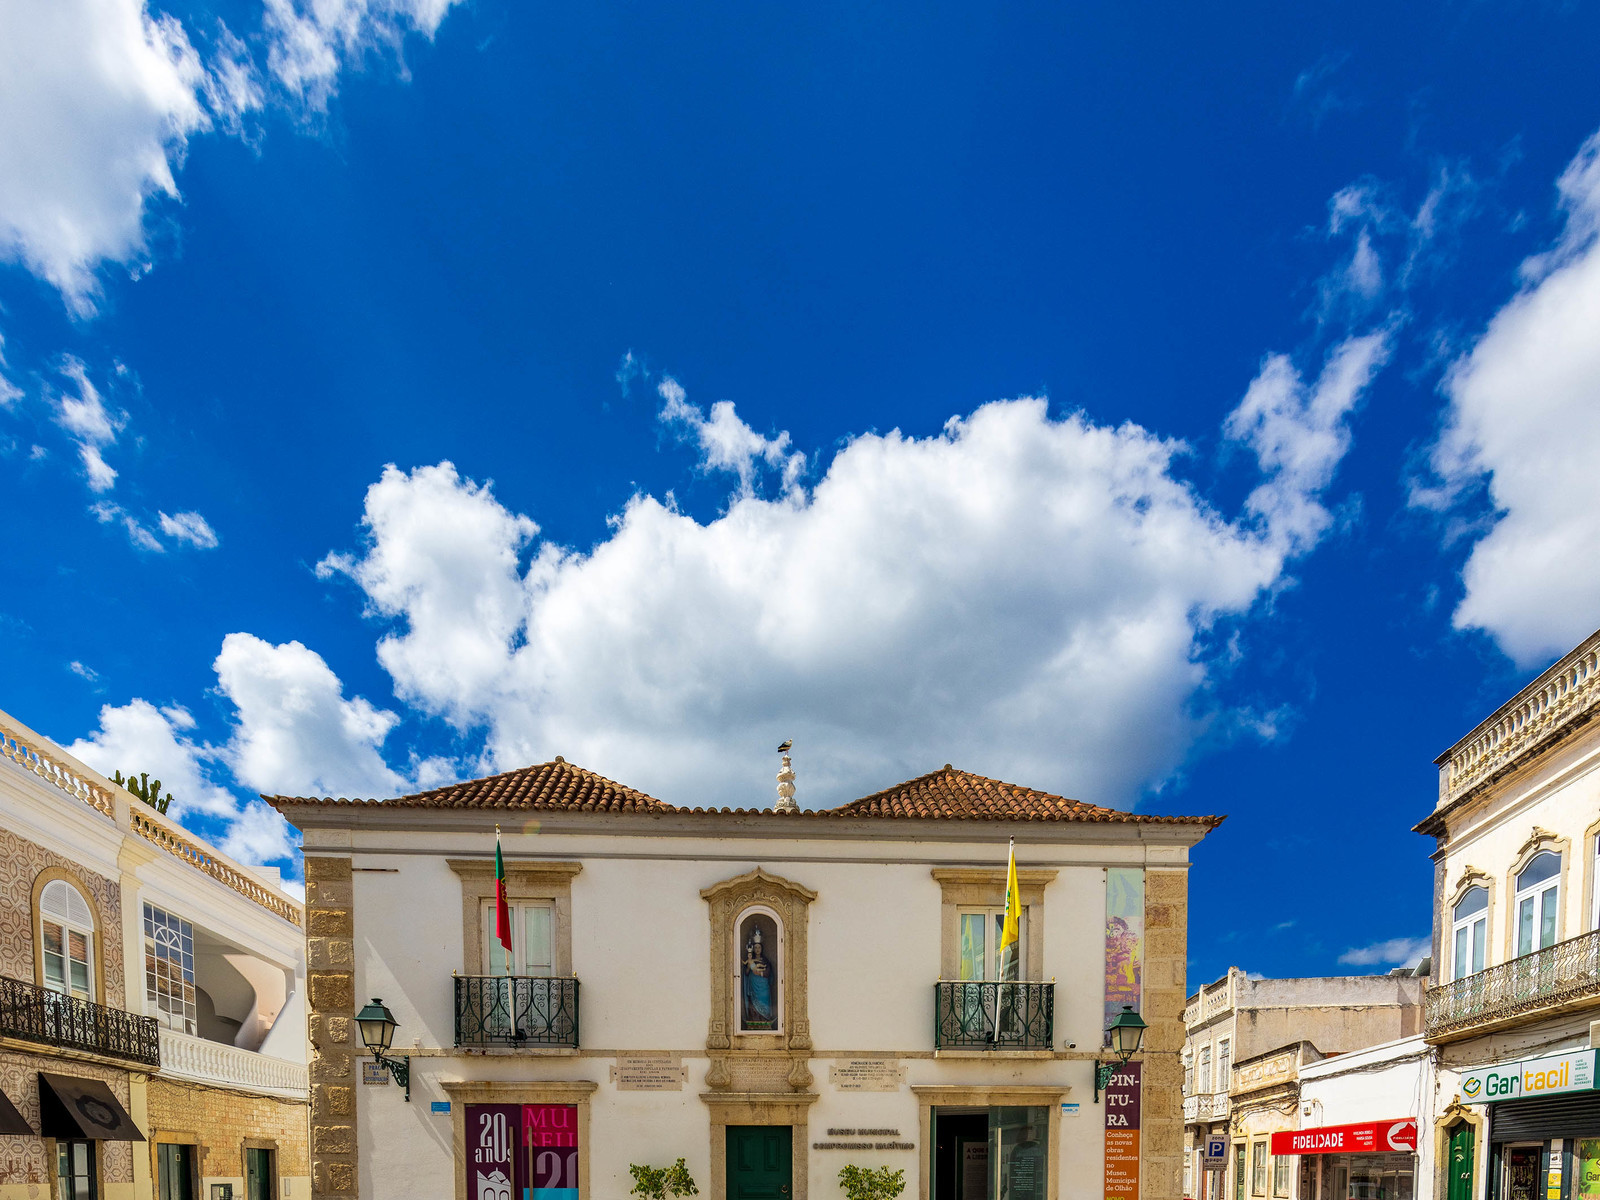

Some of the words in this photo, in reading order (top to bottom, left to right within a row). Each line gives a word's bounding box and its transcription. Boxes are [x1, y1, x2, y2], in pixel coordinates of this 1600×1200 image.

[1108, 1074, 1140, 1086] PIN-
[1108, 1094, 1134, 1106] TU-
[526, 1108, 569, 1128] MU
[1107, 1114, 1128, 1126] RA
[480, 1112, 507, 1163] 20
[858, 1128, 900, 1136] MUNICIPAL
[1106, 1131, 1133, 1139] Conheça
[875, 1142, 915, 1150] MARÍTIMO
[1292, 1132, 1344, 1149] FIDELIDADE
[1212, 1143, 1222, 1156] P
